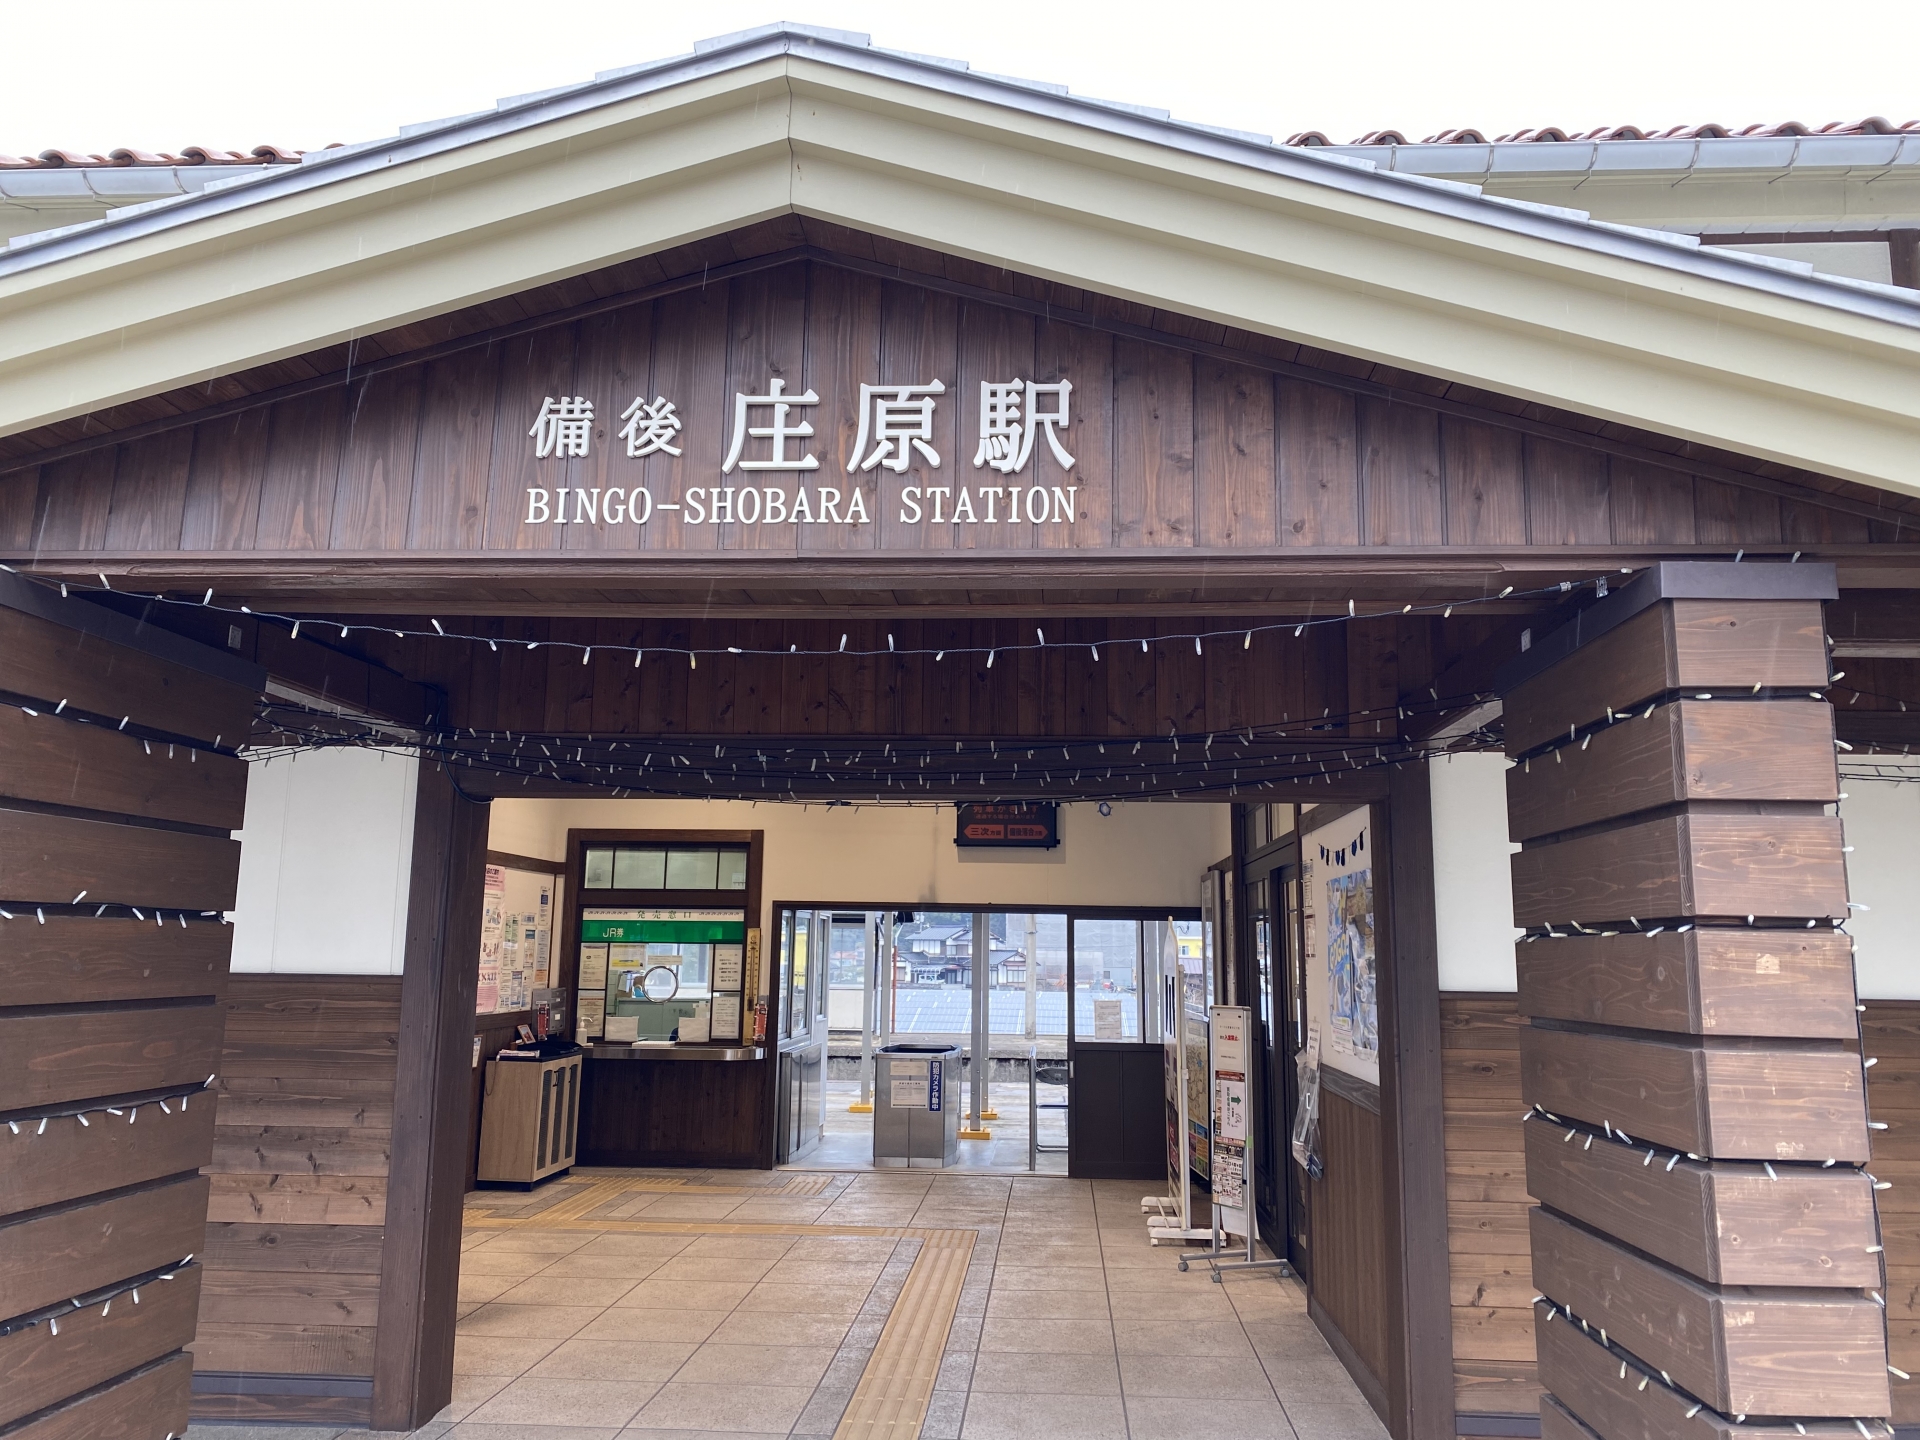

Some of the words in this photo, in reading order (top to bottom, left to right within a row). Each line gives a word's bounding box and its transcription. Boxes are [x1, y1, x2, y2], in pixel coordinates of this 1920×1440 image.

[525, 486, 871, 525] BINGO-SHOBARA
[899, 486, 1078, 524] STATION
[603, 927, 624, 938] JR券
[932, 1062, 940, 1110] 防犯カメラ作動中
